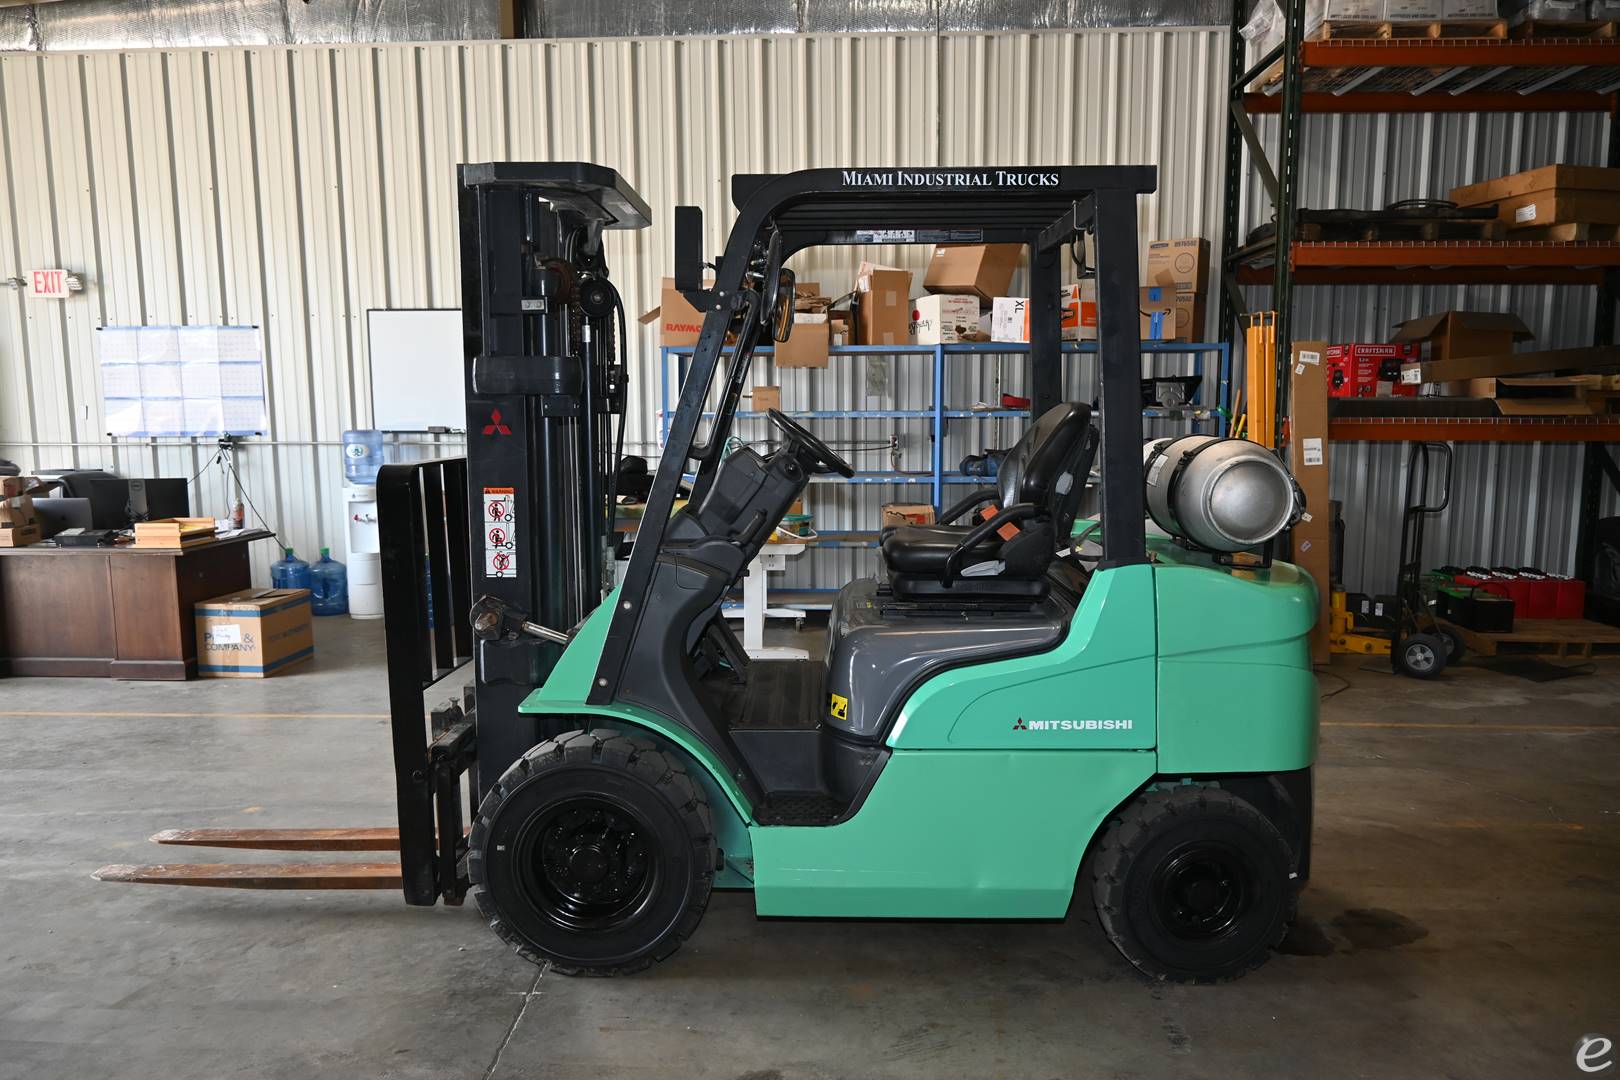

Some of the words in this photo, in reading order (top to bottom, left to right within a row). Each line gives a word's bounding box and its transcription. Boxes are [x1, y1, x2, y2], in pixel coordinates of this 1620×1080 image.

[33, 271, 62, 294] EXIT
[1015, 300, 1025, 313] XL
[666, 323, 702, 333] RAYMO
[1028, 720, 1133, 731] MITSUBISHI
